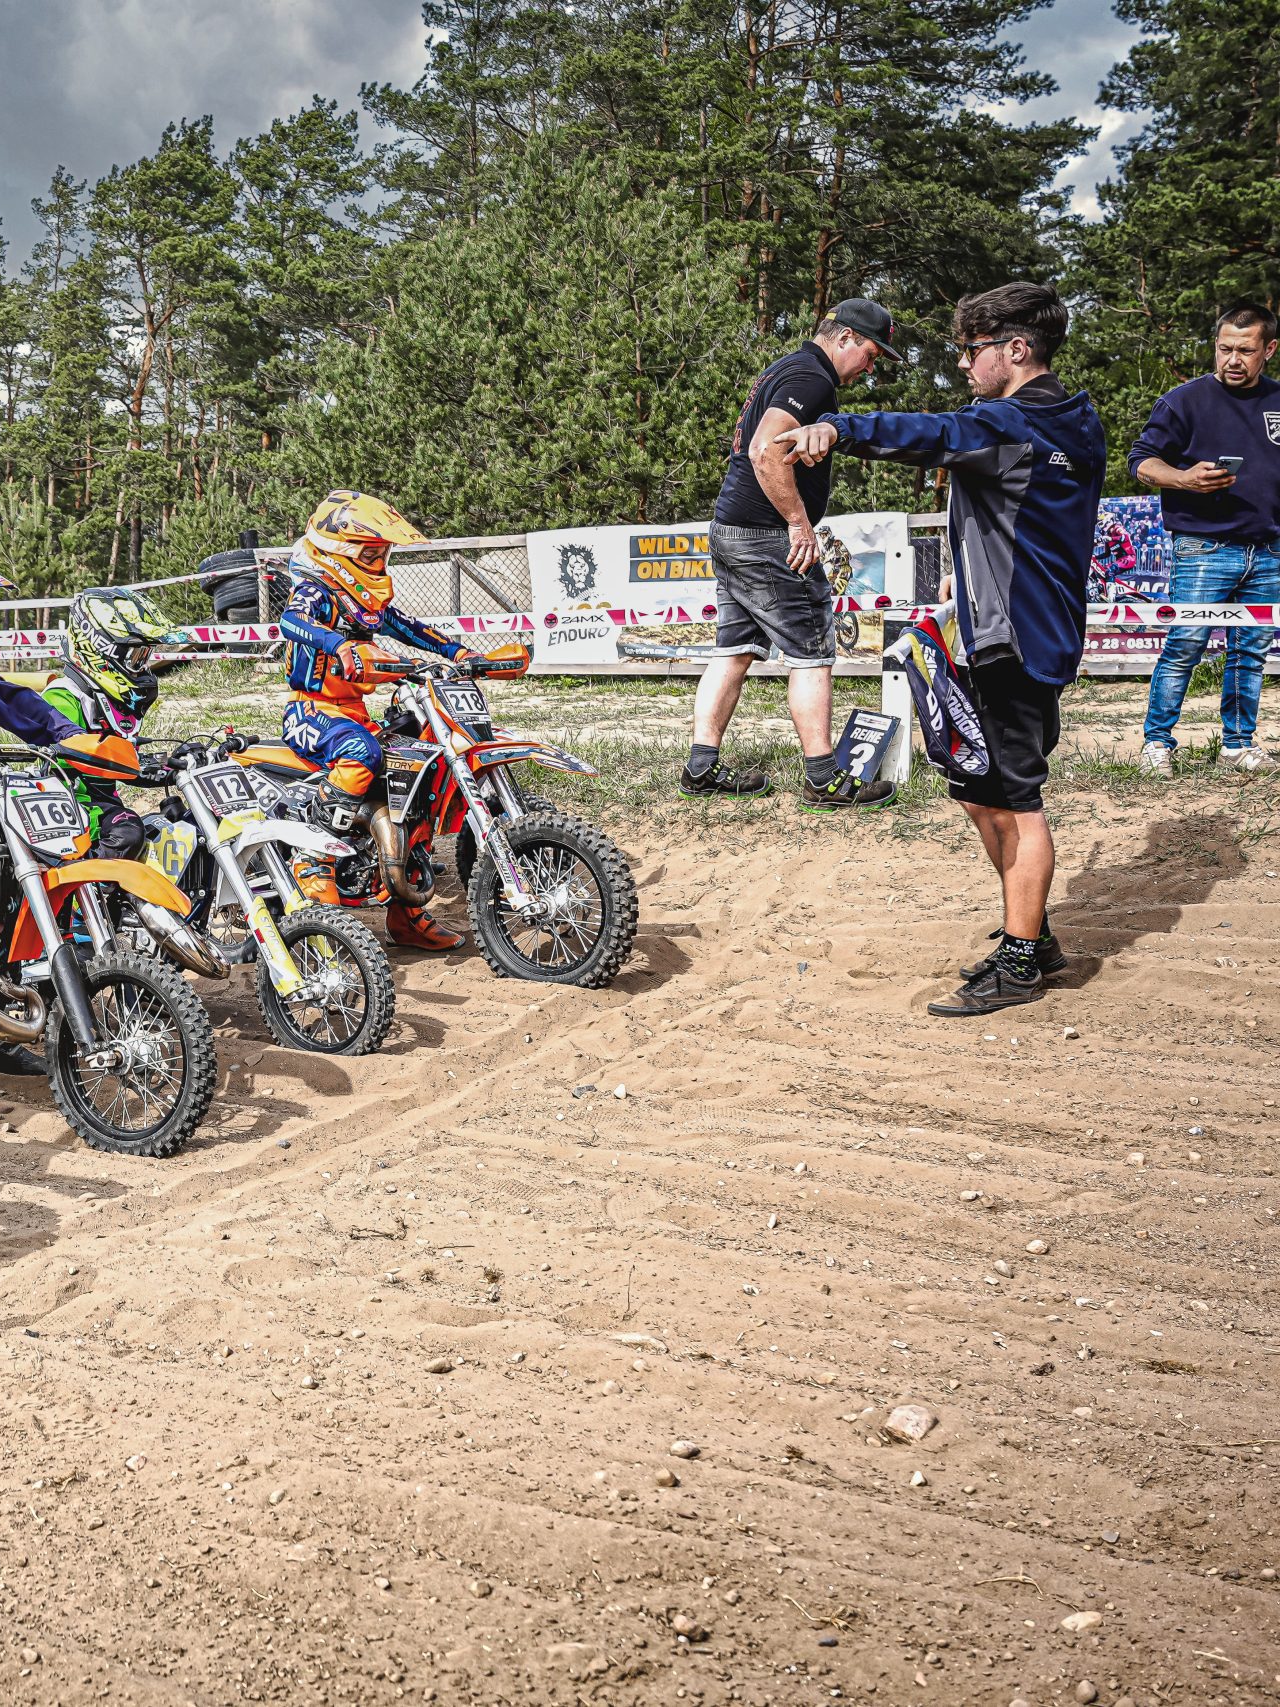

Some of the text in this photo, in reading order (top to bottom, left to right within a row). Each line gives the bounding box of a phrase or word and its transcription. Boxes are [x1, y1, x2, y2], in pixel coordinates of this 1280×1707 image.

[638, 535, 709, 555] WILD N
[637, 561, 667, 580] ON
[561, 614, 606, 625] 24MX
[1180, 610, 1243, 620] 24MX
[547, 627, 611, 647] ENDURO
[1102, 637, 1119, 650] 28
[449, 692, 484, 713] 218
[849, 727, 885, 745] REIHE
[216, 777, 246, 800] 12
[29, 802, 78, 827] 169
